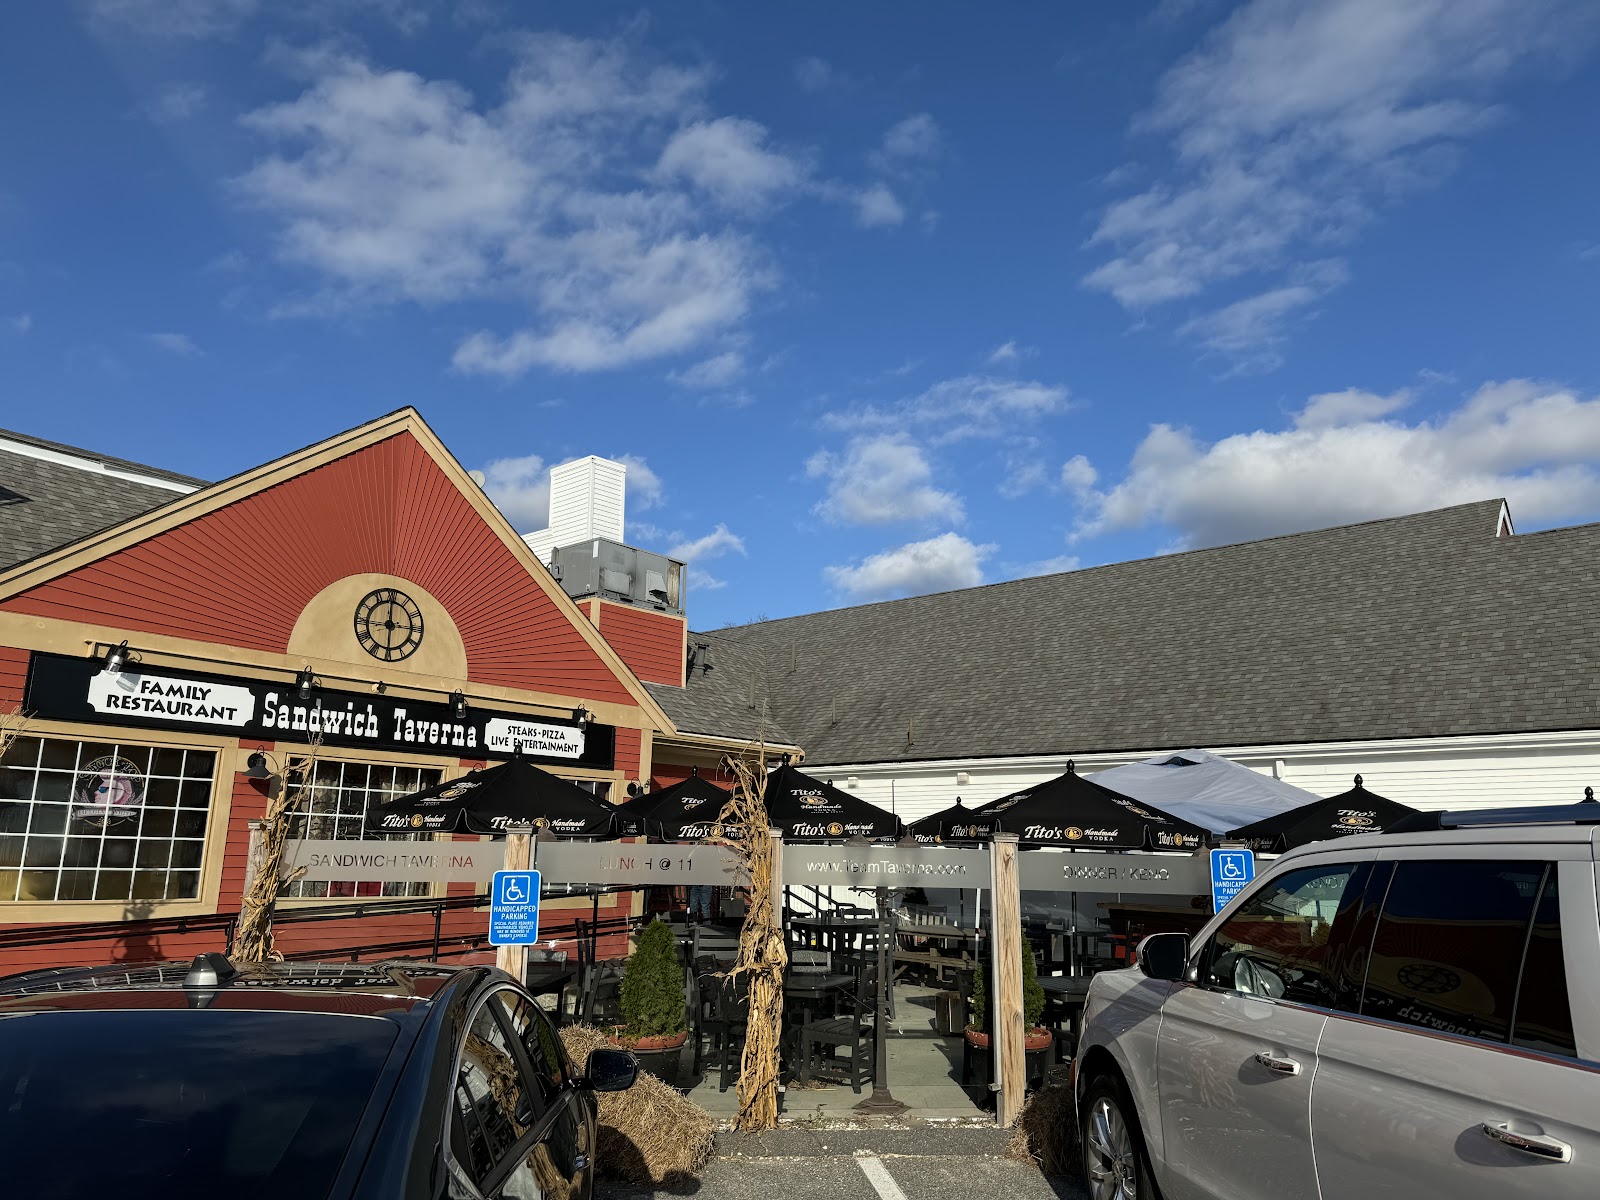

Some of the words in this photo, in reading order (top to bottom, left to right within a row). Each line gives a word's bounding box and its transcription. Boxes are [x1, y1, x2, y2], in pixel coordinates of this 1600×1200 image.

[141, 680, 211, 700] FAMILY
[106, 694, 238, 720] RESTAURANT
[262, 692, 379, 738] Sandwich
[393, 708, 477, 748] Taverna
[491, 736, 509, 746] LIVE
[514, 738, 578, 754] ENTERTAINMENT
[552, 818, 586, 827] Handmade
[1084, 828, 1119, 837] Handmade
[310, 854, 397, 867] SANDWICH
[402, 855, 474, 868] TAVERNA
[600, 857, 652, 870] LUNCH
[659, 858, 670, 870] @
[678, 858, 692, 870] 11
[806, 860, 966, 874] www.TeamTaverna.com
[1063, 865, 1117, 880] DINNER
[1130, 868, 1170, 880] KENO
